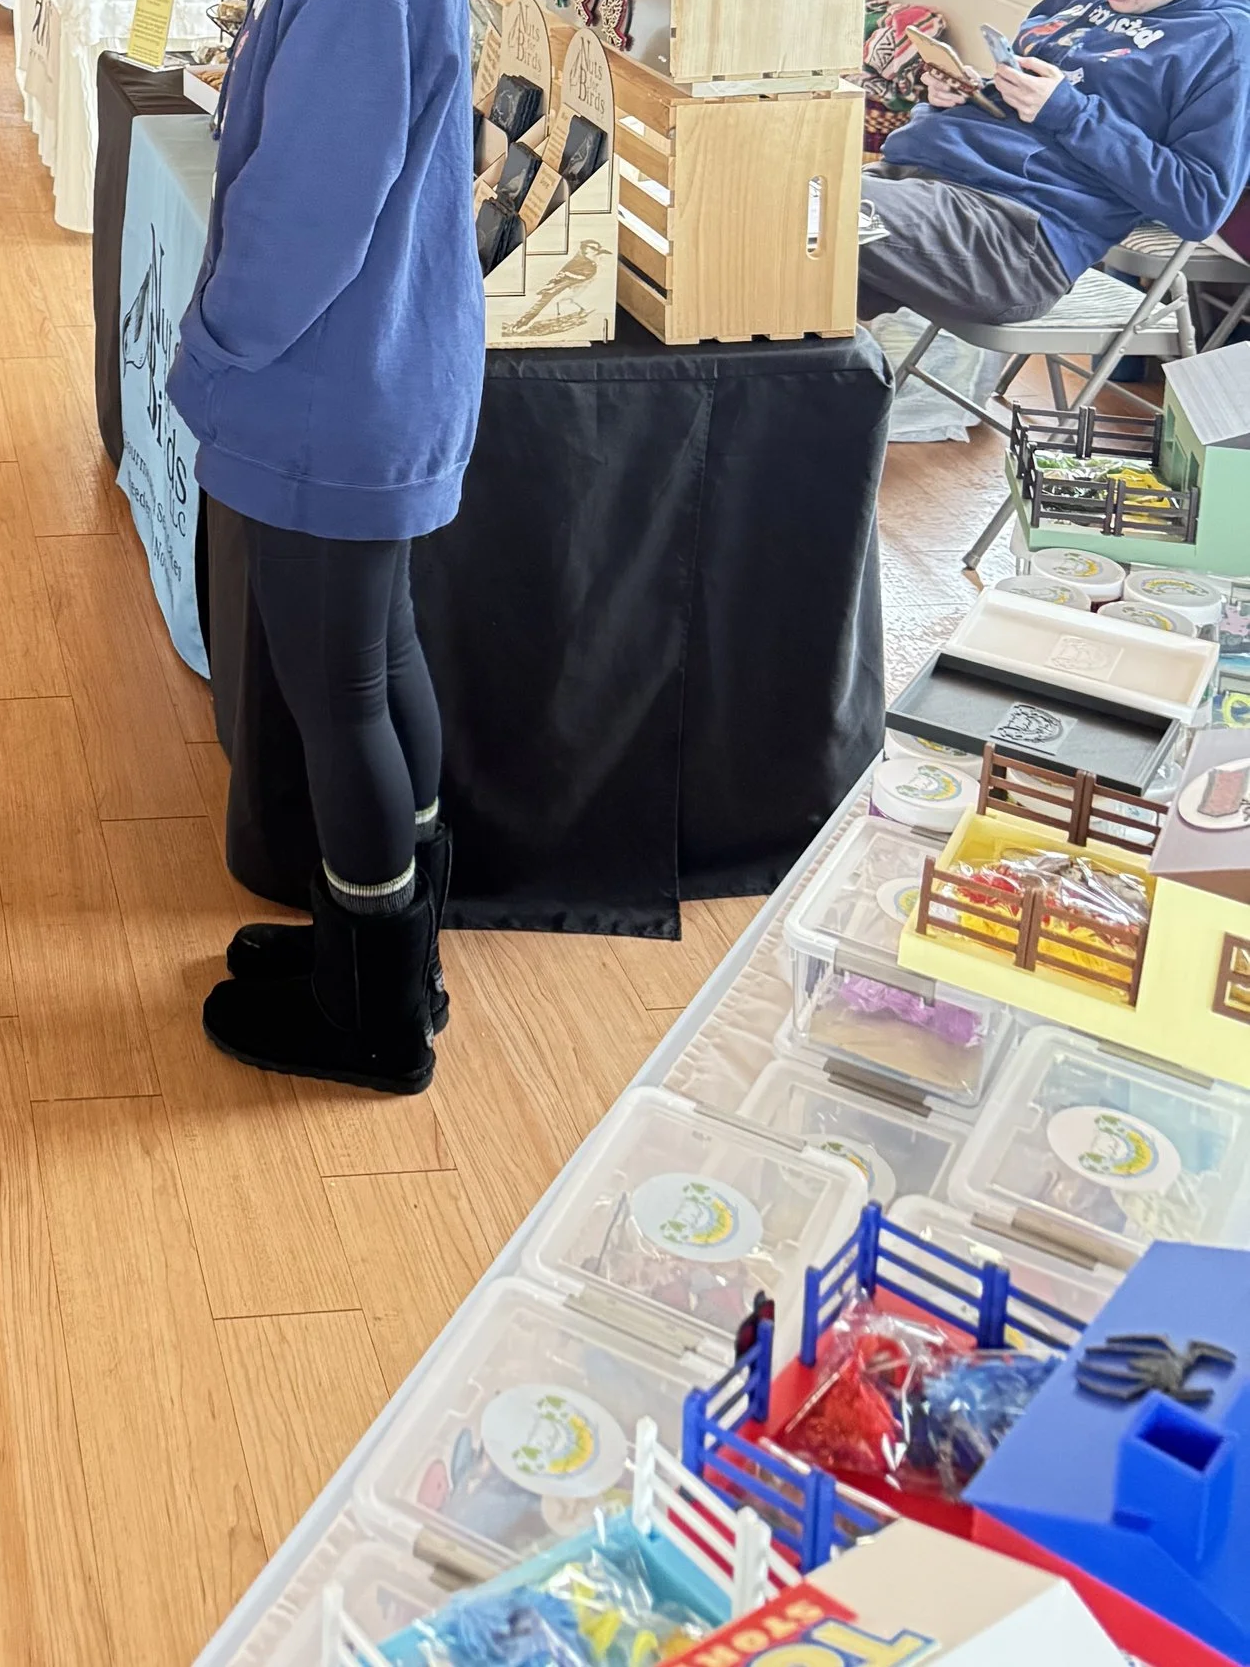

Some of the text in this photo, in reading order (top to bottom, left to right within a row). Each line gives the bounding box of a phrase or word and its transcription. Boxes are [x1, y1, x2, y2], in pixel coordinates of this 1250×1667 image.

[518, 1, 540, 42] Nuts
[516, 29, 542, 72] Birds
[580, 37, 603, 81] Nuts
[578, 66, 606, 114] Birds
[147, 310, 187, 505] Bids
